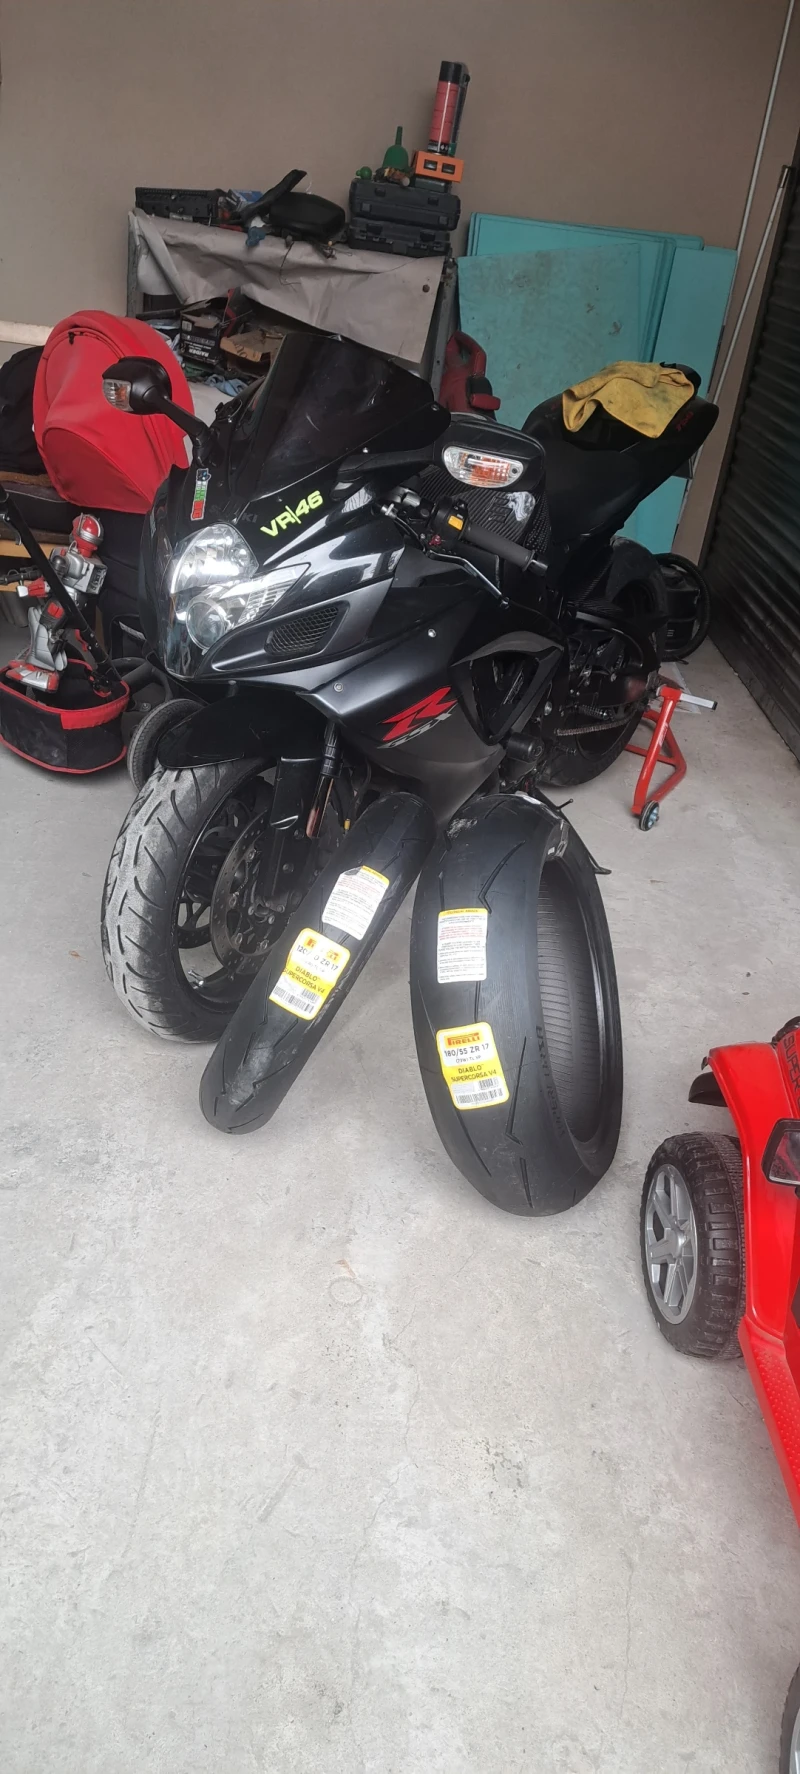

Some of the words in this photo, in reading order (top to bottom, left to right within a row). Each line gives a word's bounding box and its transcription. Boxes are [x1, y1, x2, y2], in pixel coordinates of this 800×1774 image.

[320, 958, 331, 967] ZR
[331, 963, 339, 972] 17
[447, 1032, 480, 1046] PIRELLI
[444, 1047, 468, 1057] 180/55
[470, 1045, 480, 1054] ZR
[481, 1042, 490, 1051] 17
[451, 1071, 488, 1082] SUPERCORSA
